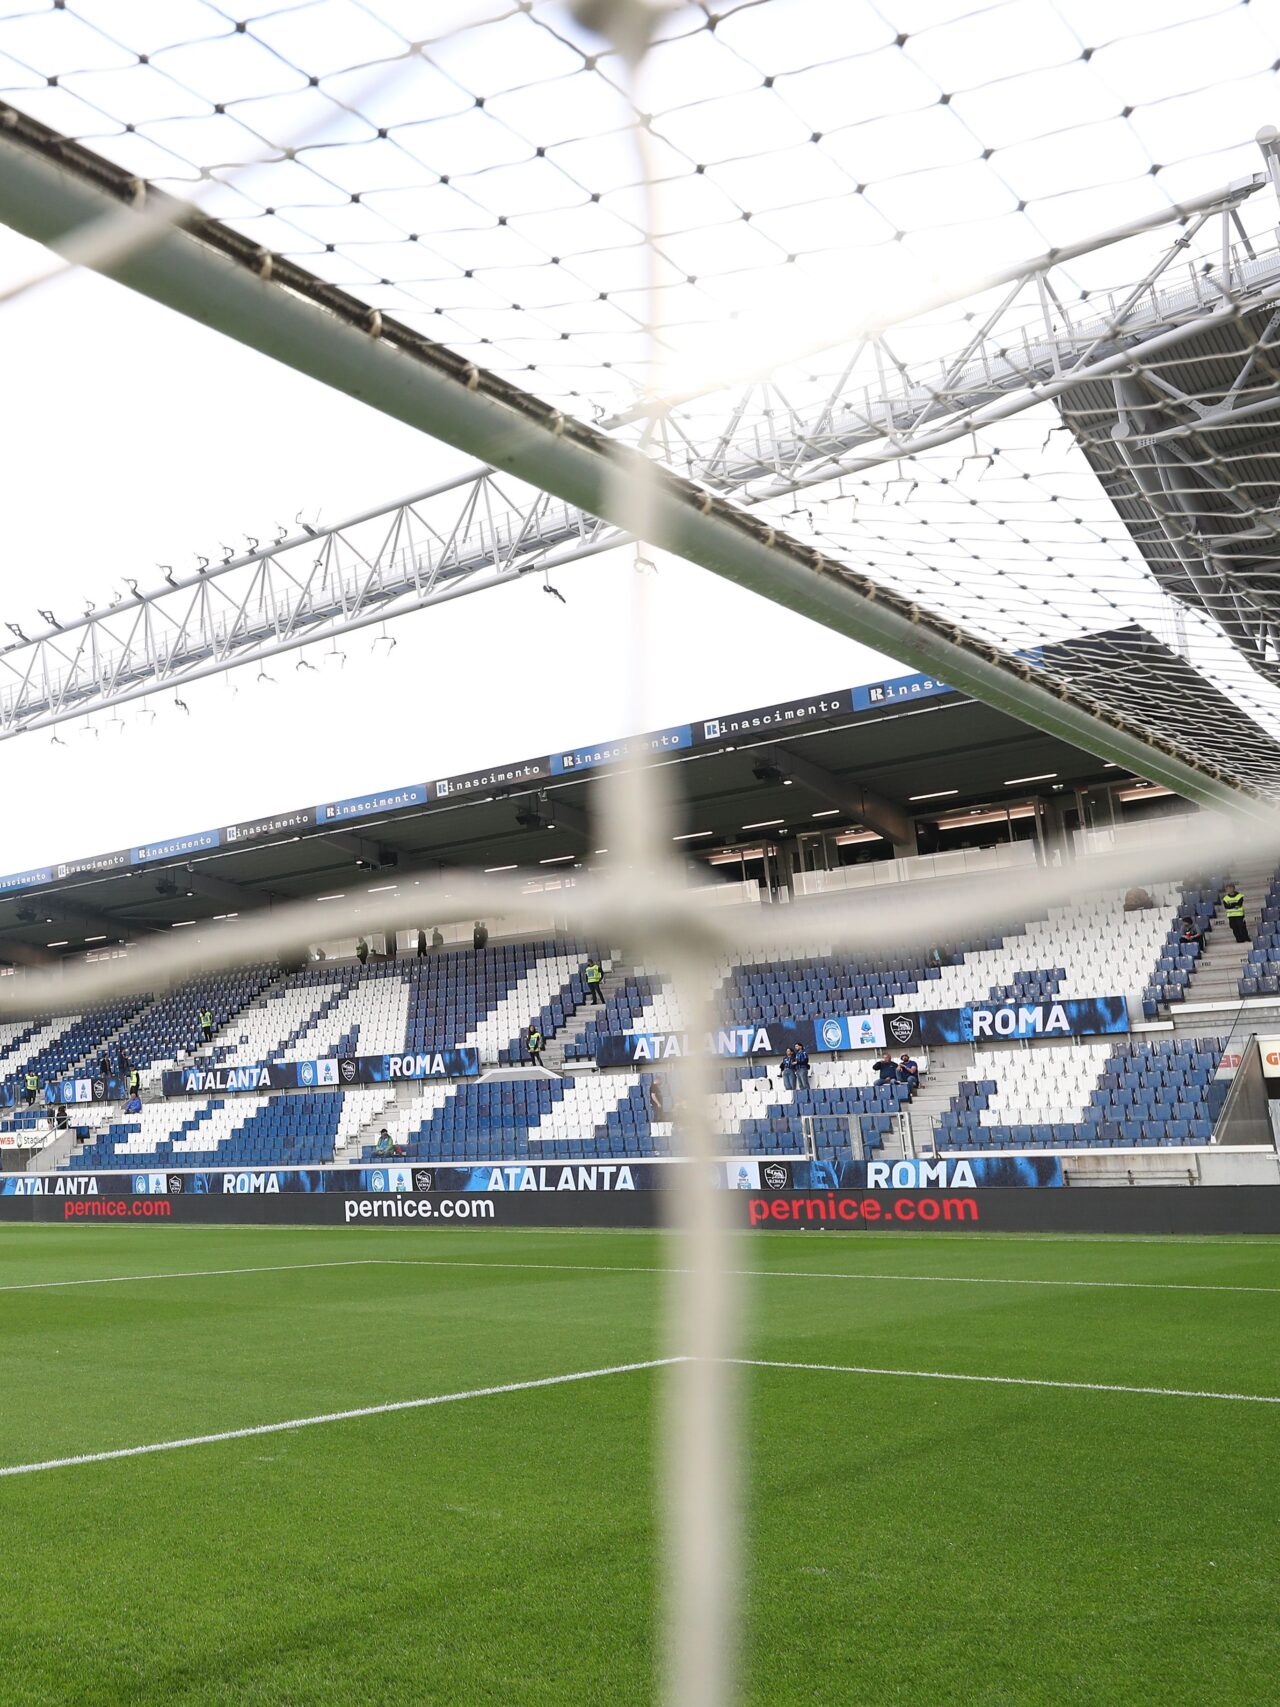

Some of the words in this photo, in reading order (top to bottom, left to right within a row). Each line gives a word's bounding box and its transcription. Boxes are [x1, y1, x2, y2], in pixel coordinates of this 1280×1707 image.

[869, 679, 945, 705] Rinasc
[704, 699, 840, 739] Rinascimento
[562, 734, 679, 768] Rinascinto
[436, 764, 540, 797] Rinascimento
[325, 791, 417, 819] Rinascimento
[226, 814, 309, 841] Rinascimento
[138, 835, 212, 859] Rinascimento
[57, 855, 125, 878] Rinascimento
[633, 1028, 772, 1060] ATALANTA
[972, 1005, 1070, 1037] ROMA
[185, 1067, 271, 1091] ATALANTA
[389, 1053, 446, 1077] ROMA
[14, 1176, 99, 1195] ATALANTA
[222, 1173, 280, 1194] ROMA
[487, 1166, 635, 1191] ATALANTA
[867, 1161, 978, 1189] ROMA
[64, 1196, 171, 1219] pernice.com
[344, 1195, 495, 1222] pernice.com
[748, 1193, 979, 1225] pernice.com
